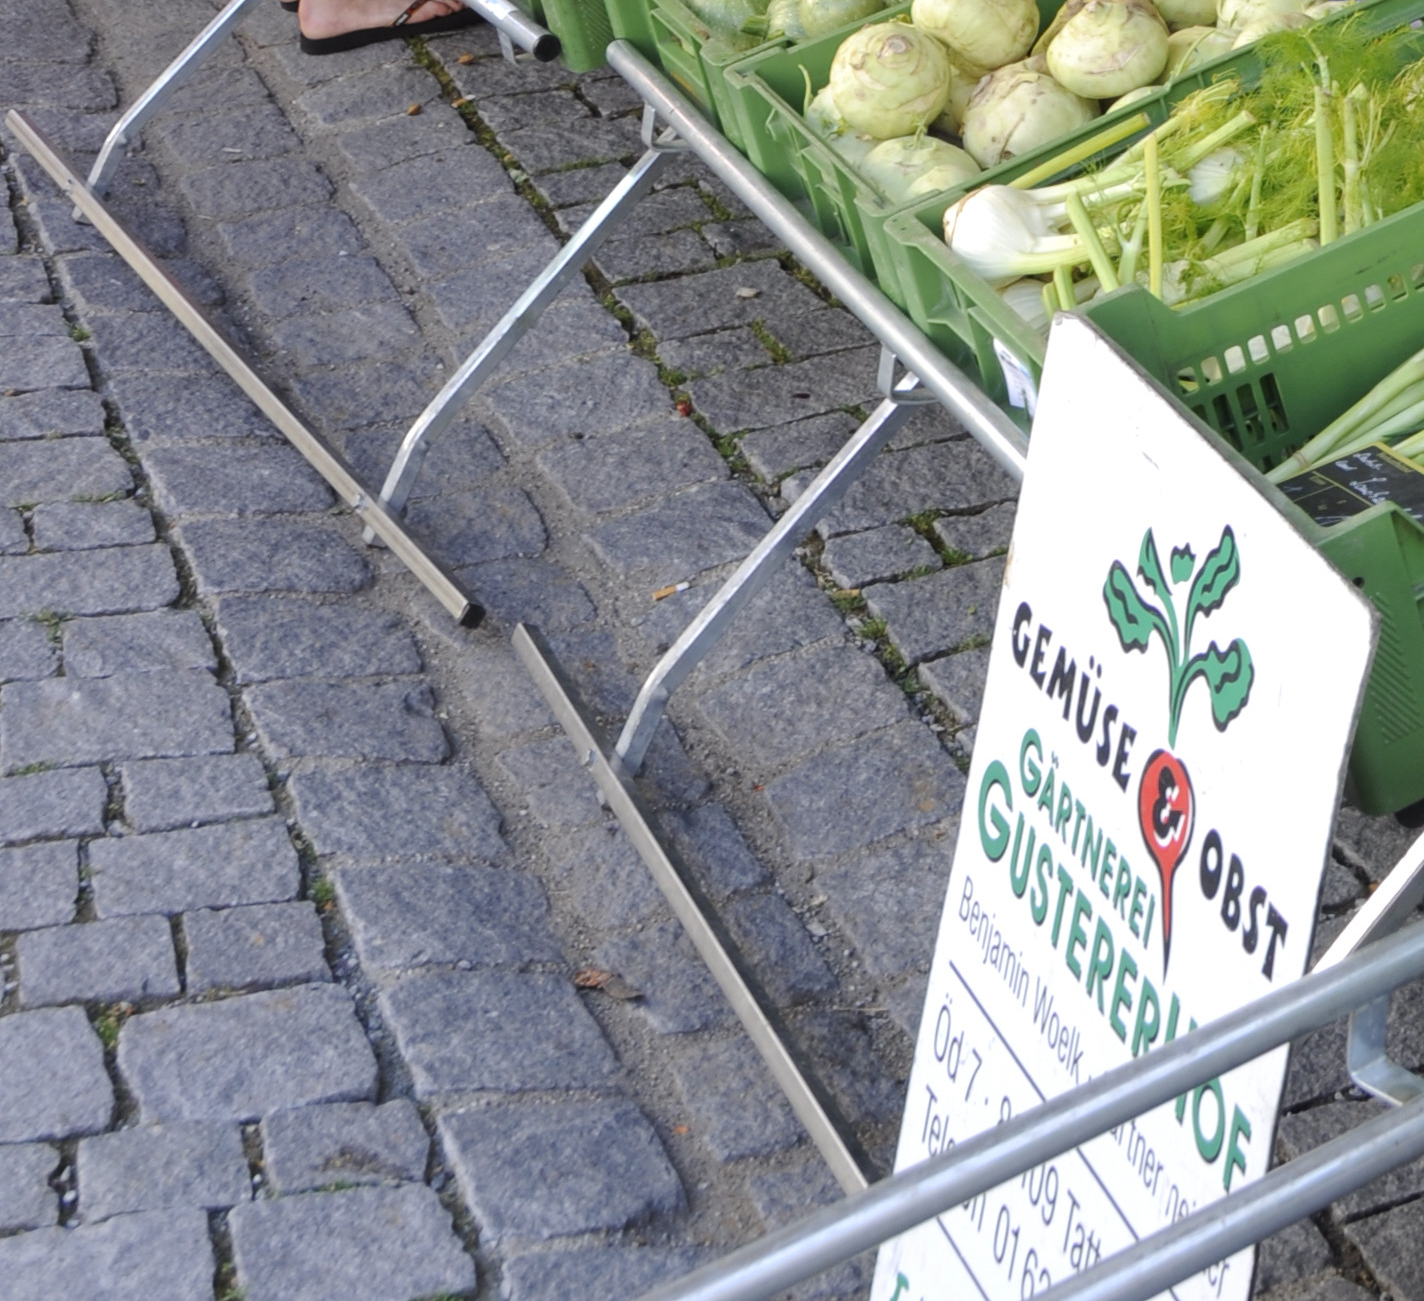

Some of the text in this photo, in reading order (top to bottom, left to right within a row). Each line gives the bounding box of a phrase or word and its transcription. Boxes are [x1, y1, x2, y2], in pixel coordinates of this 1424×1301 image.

[1012, 601, 1137, 794] GEMÜSE
[1200, 828, 1289, 982] OBST
[1020, 727, 1156, 950] GÄRTNEREI
[934, 993, 965, 1084] Öd
[958, 874, 1030, 1009] Benjamin
[1033, 975, 1084, 1086] Woelk
